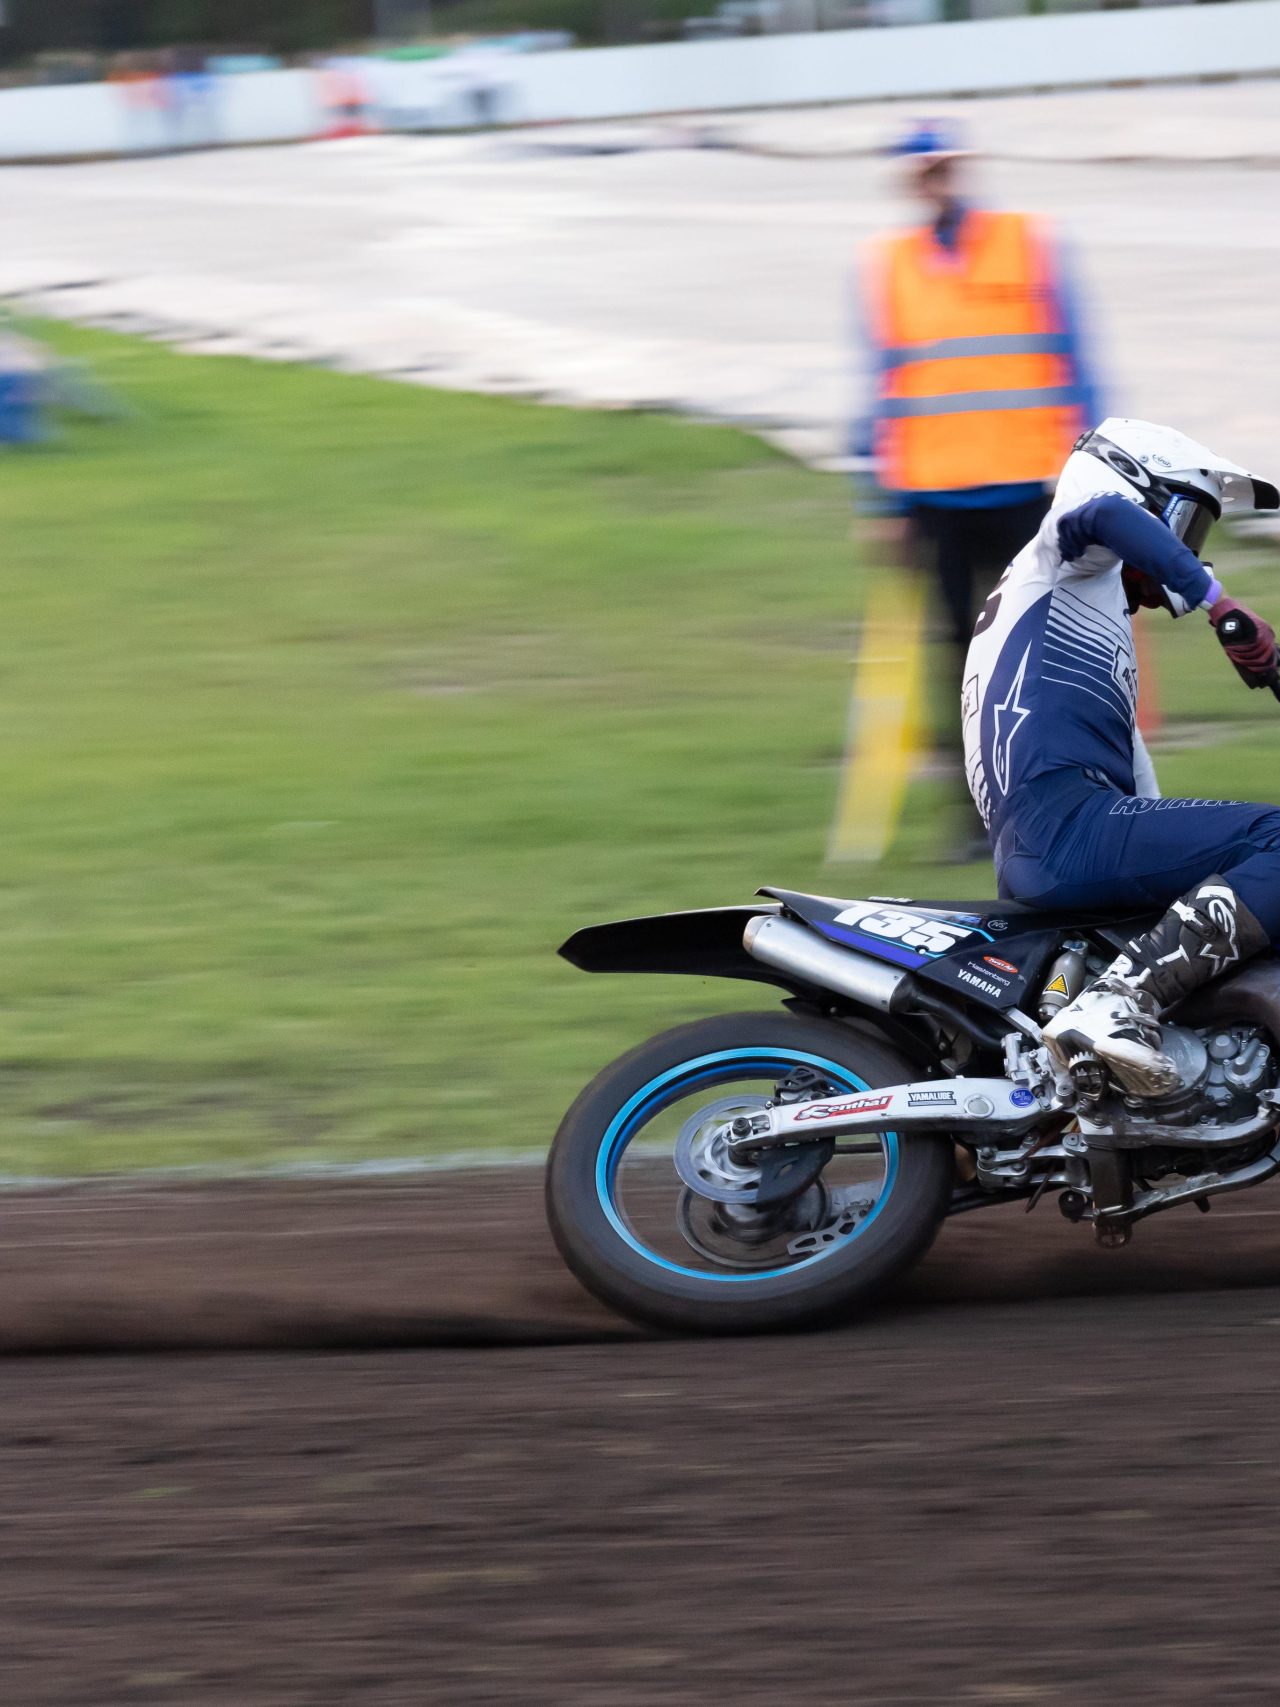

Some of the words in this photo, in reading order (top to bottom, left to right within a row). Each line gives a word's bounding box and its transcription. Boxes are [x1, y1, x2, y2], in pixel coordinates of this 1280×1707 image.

[832, 904, 974, 954] 135
[956, 969, 1002, 998] YAMAHA
[797, 1096, 889, 1119] Renthal
[910, 1091, 953, 1102] YAMALUBE
